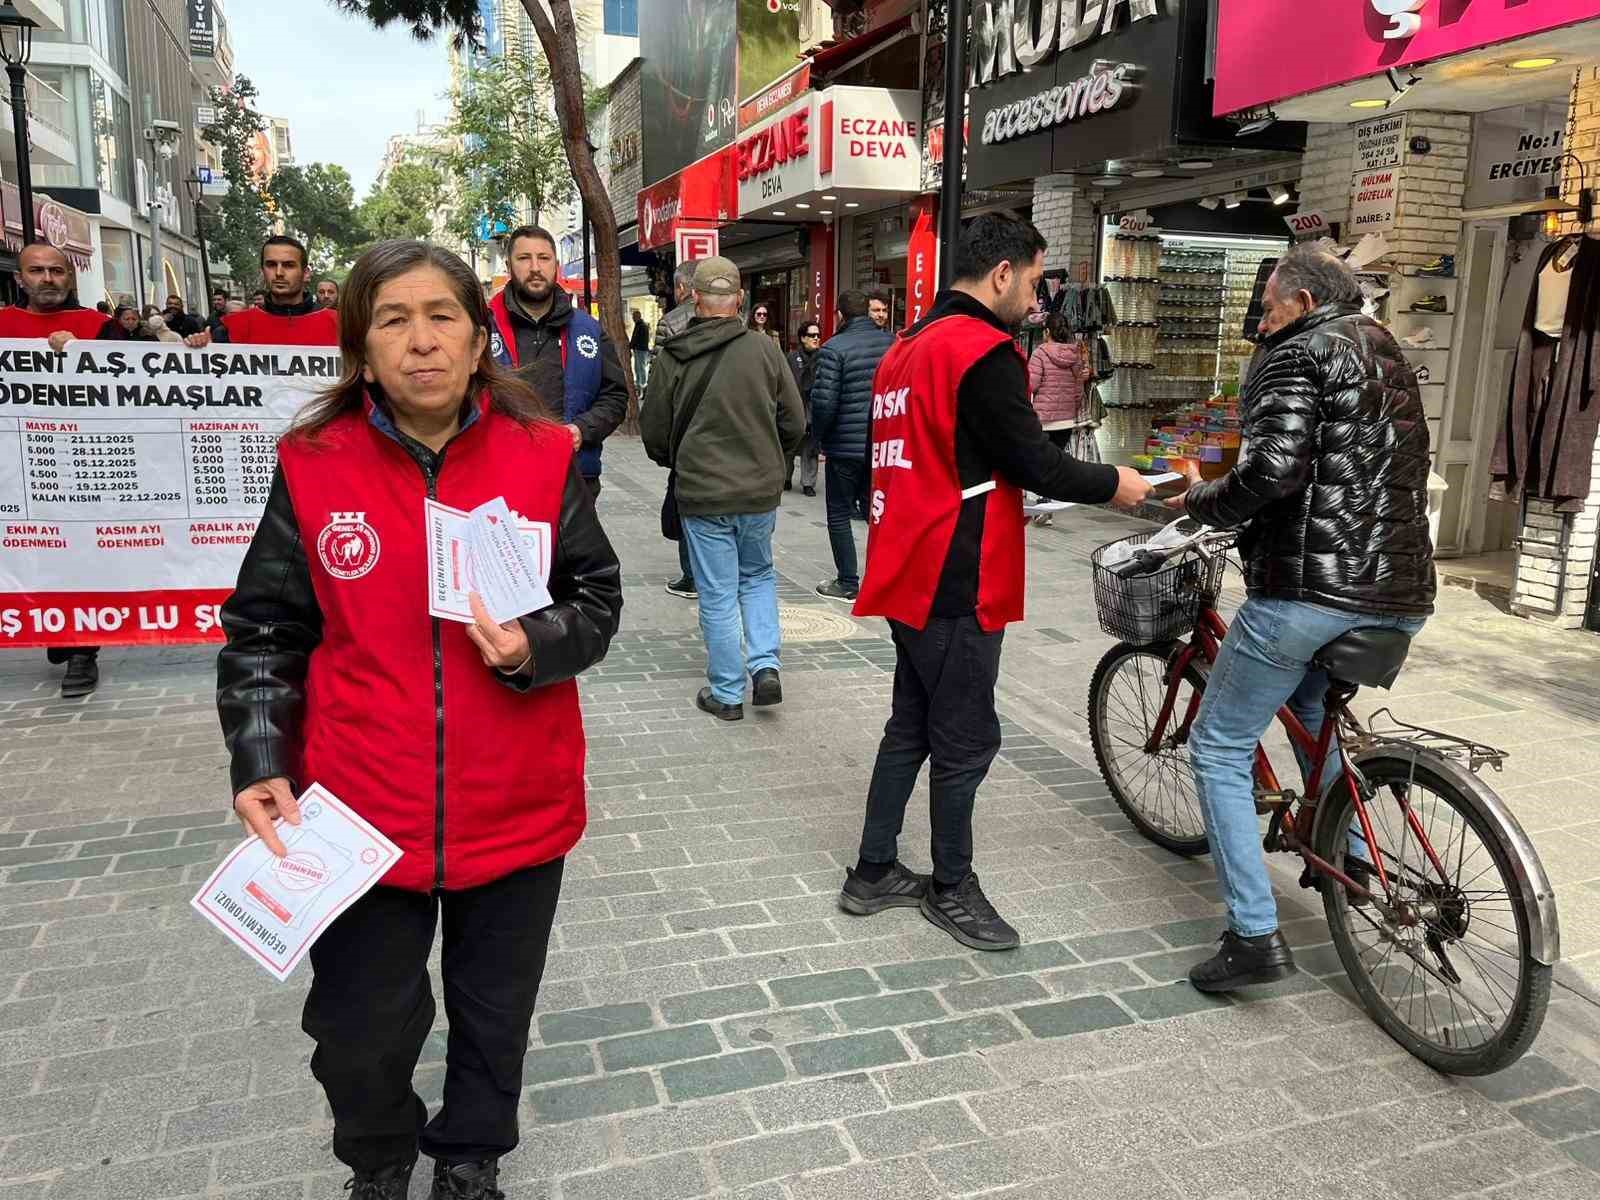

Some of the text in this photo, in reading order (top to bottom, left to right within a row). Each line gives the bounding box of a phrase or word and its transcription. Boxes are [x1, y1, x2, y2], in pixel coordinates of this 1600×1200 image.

[981, 58, 1128, 145] accessories
[841, 118, 917, 137] ECZANE
[736, 105, 809, 184] ECZANE
[850, 140, 907, 158] DEVA
[1489, 155, 1561, 180] ERCİYES
[762, 176, 782, 199] DEVA
[1386, 212, 1391, 221] 2
[1291, 214, 1323, 231] 200
[76, 351, 136, 378] A.Ş.
[117, 384, 263, 410] MAAŞLAR
[26, 421, 78, 432] MAYIS AYI
[190, 422, 259, 431] HAZİRAN AYI
[27, 434, 135, 444] 5.000 21.11.2025
[190, 435, 222, 443] 4.500
[72, 447, 136, 456] 28.11.2025
[191, 445, 223, 454] 7.000
[28, 458, 137, 468] 7.500 05.12.2025
[192, 455, 224, 464] 6.000
[193, 465, 225, 474] 5.500
[75, 471, 138, 480] 12.12.2025
[194, 475, 226, 485] 6.500
[76, 482, 139, 491] 19.12.2025
[195, 485, 227, 495] 6.500
[32, 492, 182, 503] KALAN KISIM 22.12.2025
[196, 496, 228, 505] 9.000
[41, 526, 59, 536] AYI
[96, 525, 161, 536] KASIM AYI
[190, 522, 255, 533] ARALIK AYI
[29, 607, 66, 633] 10
[139, 605, 179, 630] LU
[214, 889, 287, 955] GEÇİNEMİYORUZ!
